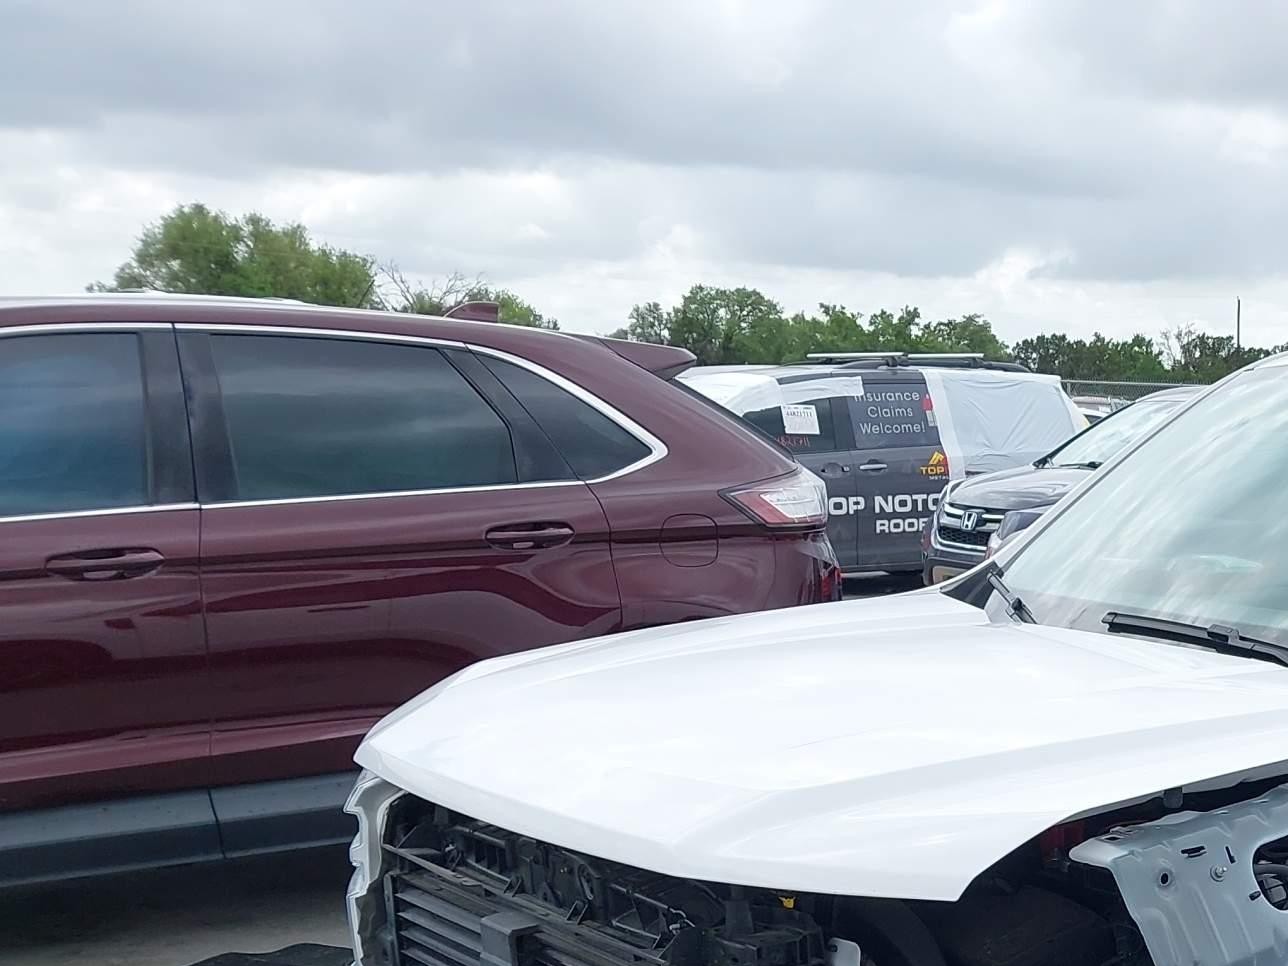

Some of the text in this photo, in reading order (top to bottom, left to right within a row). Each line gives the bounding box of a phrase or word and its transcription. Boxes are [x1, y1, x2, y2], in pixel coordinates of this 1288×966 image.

[867, 405, 913, 418] Claims
[859, 421, 926, 435] Welcome!
[920, 466, 945, 475] TOP
[828, 494, 941, 515] OP NOTC
[876, 518, 929, 534] ROOF
